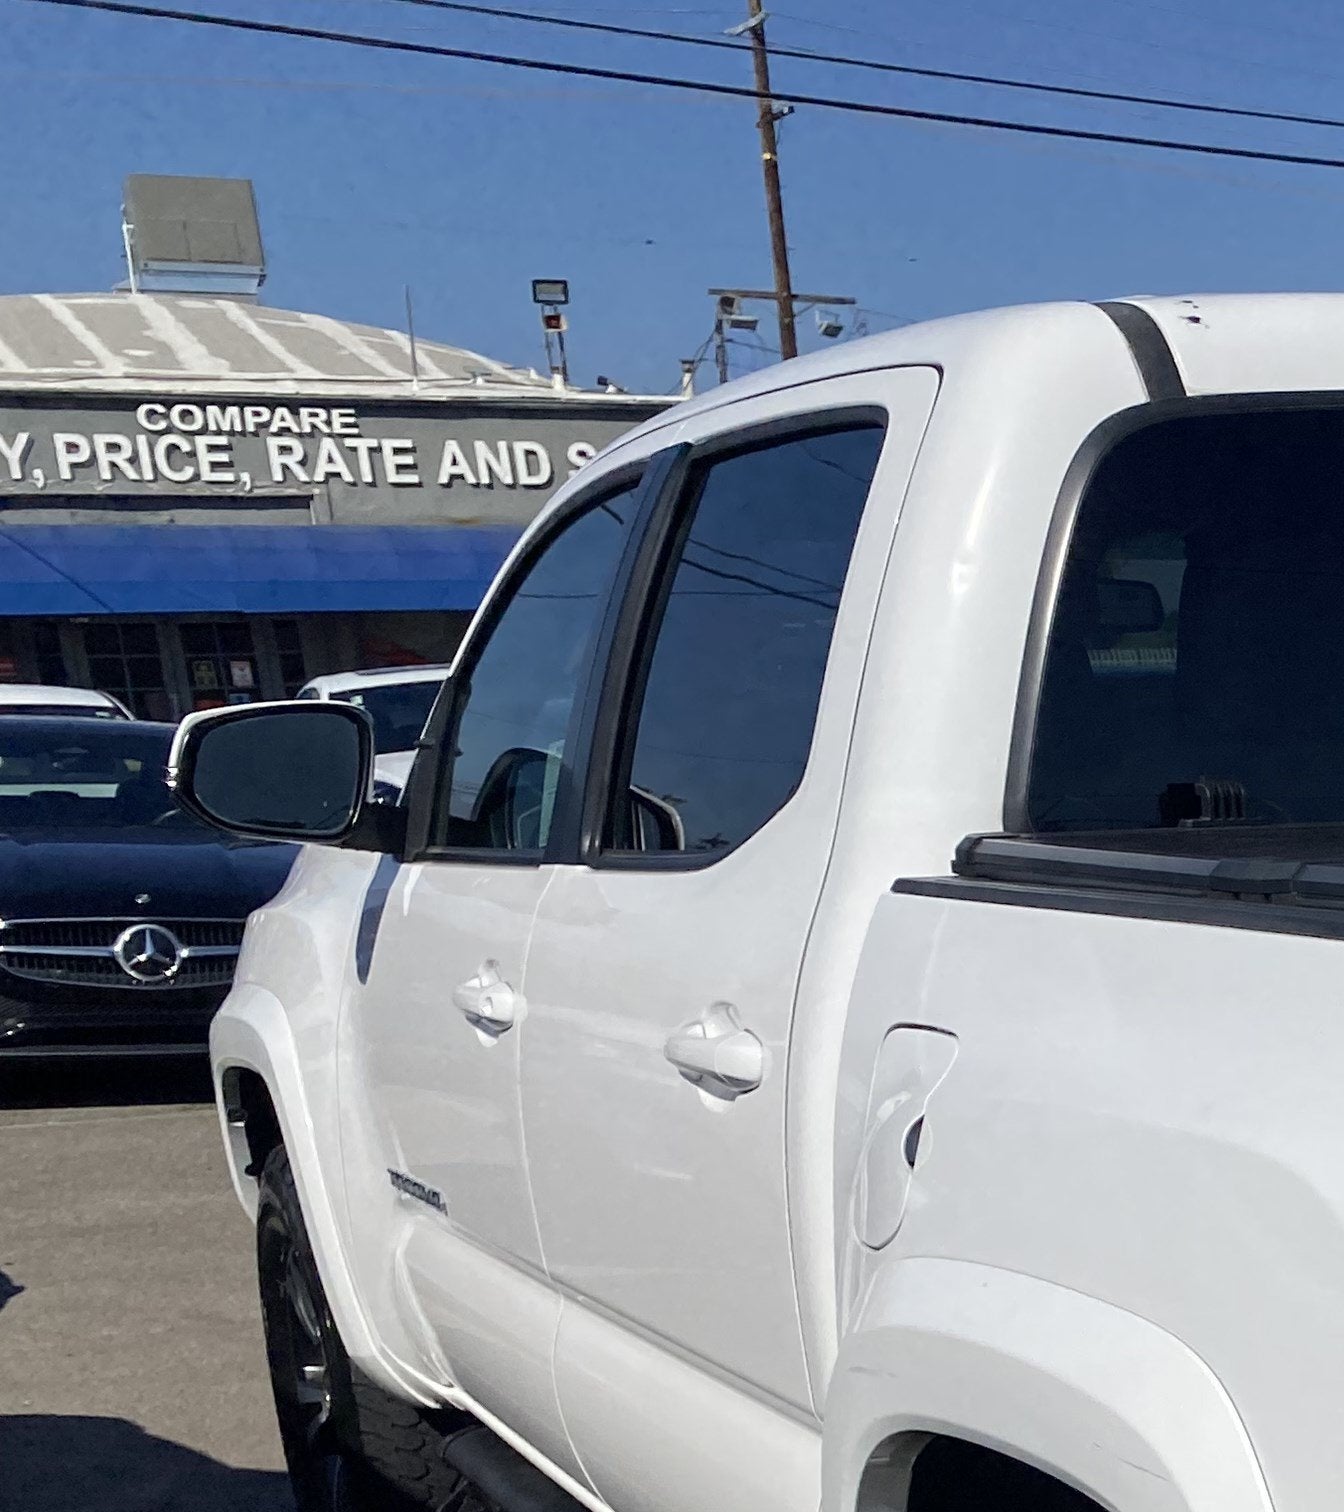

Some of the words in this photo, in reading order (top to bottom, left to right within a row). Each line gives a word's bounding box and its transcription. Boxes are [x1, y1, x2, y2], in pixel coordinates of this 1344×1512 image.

[136, 403, 359, 434] COMPARE
[53, 433, 252, 493] PRICE,
[266, 436, 420, 484] RATE
[437, 439, 552, 487] AND
